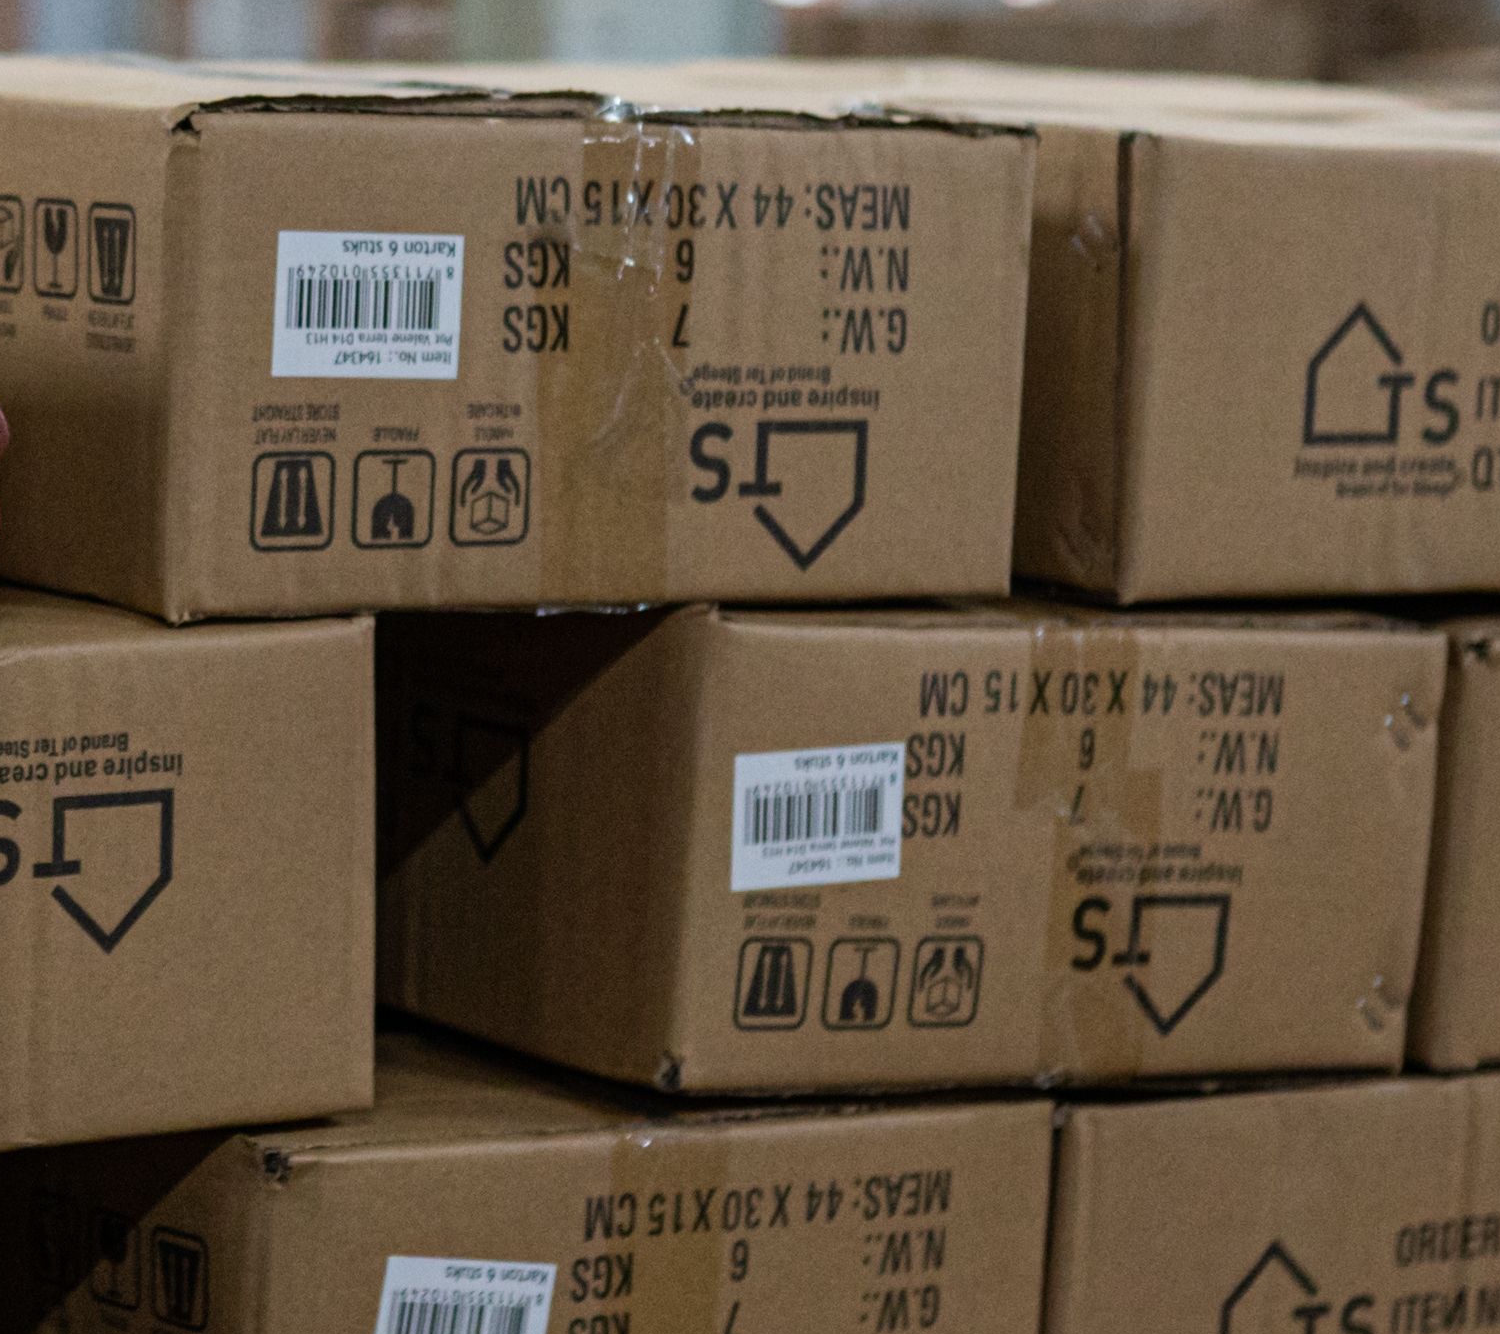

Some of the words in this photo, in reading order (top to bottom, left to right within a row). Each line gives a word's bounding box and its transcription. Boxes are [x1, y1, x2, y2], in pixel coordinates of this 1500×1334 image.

[516, 177, 571, 225] CM
[584, 180, 619, 225] 15
[632, 180, 654, 225] X
[667, 185, 707, 228] 30
[716, 183, 737, 227] X
[754, 184, 793, 227] 44
[803, 185, 912, 231] MEAS:
[343, 239, 382, 258] stuks
[386, 240, 397, 255] 6
[400, 240, 455, 257] Karton
[504, 241, 570, 288] KGS
[676, 239, 695, 282] 6
[503, 306, 570, 353] KGS
[671, 305, 690, 347] 7
[335, 351, 380, 365] 164347
[420, 350, 452, 364] Item
[919, 671, 970, 718] CM
[985, 671, 1017, 715] 15
[1030, 671, 1050, 715] X
[1061, 671, 1098, 715] 30
[1108, 671, 1127, 713] X
[1143, 671, 1177, 713] 44
[1188, 671, 1285, 717] MEAS:
[61, 735, 85, 755] of
[89, 733, 129, 751] Brand
[905, 732, 965, 780] KGS
[55, 761, 96, 784] and
[103, 753, 183, 780] inspire
[903, 793, 962, 836] KGS
[585, 1193, 637, 1239] CM
[648, 1192, 683, 1235] 15
[694, 1190, 715, 1232] X
[723, 1188, 761, 1231] 30
[774, 1185, 792, 1226] X
[806, 1181, 843, 1221] 44
[852, 1169, 952, 1220] MEAS:
[571, 1252, 633, 1302] KGS
